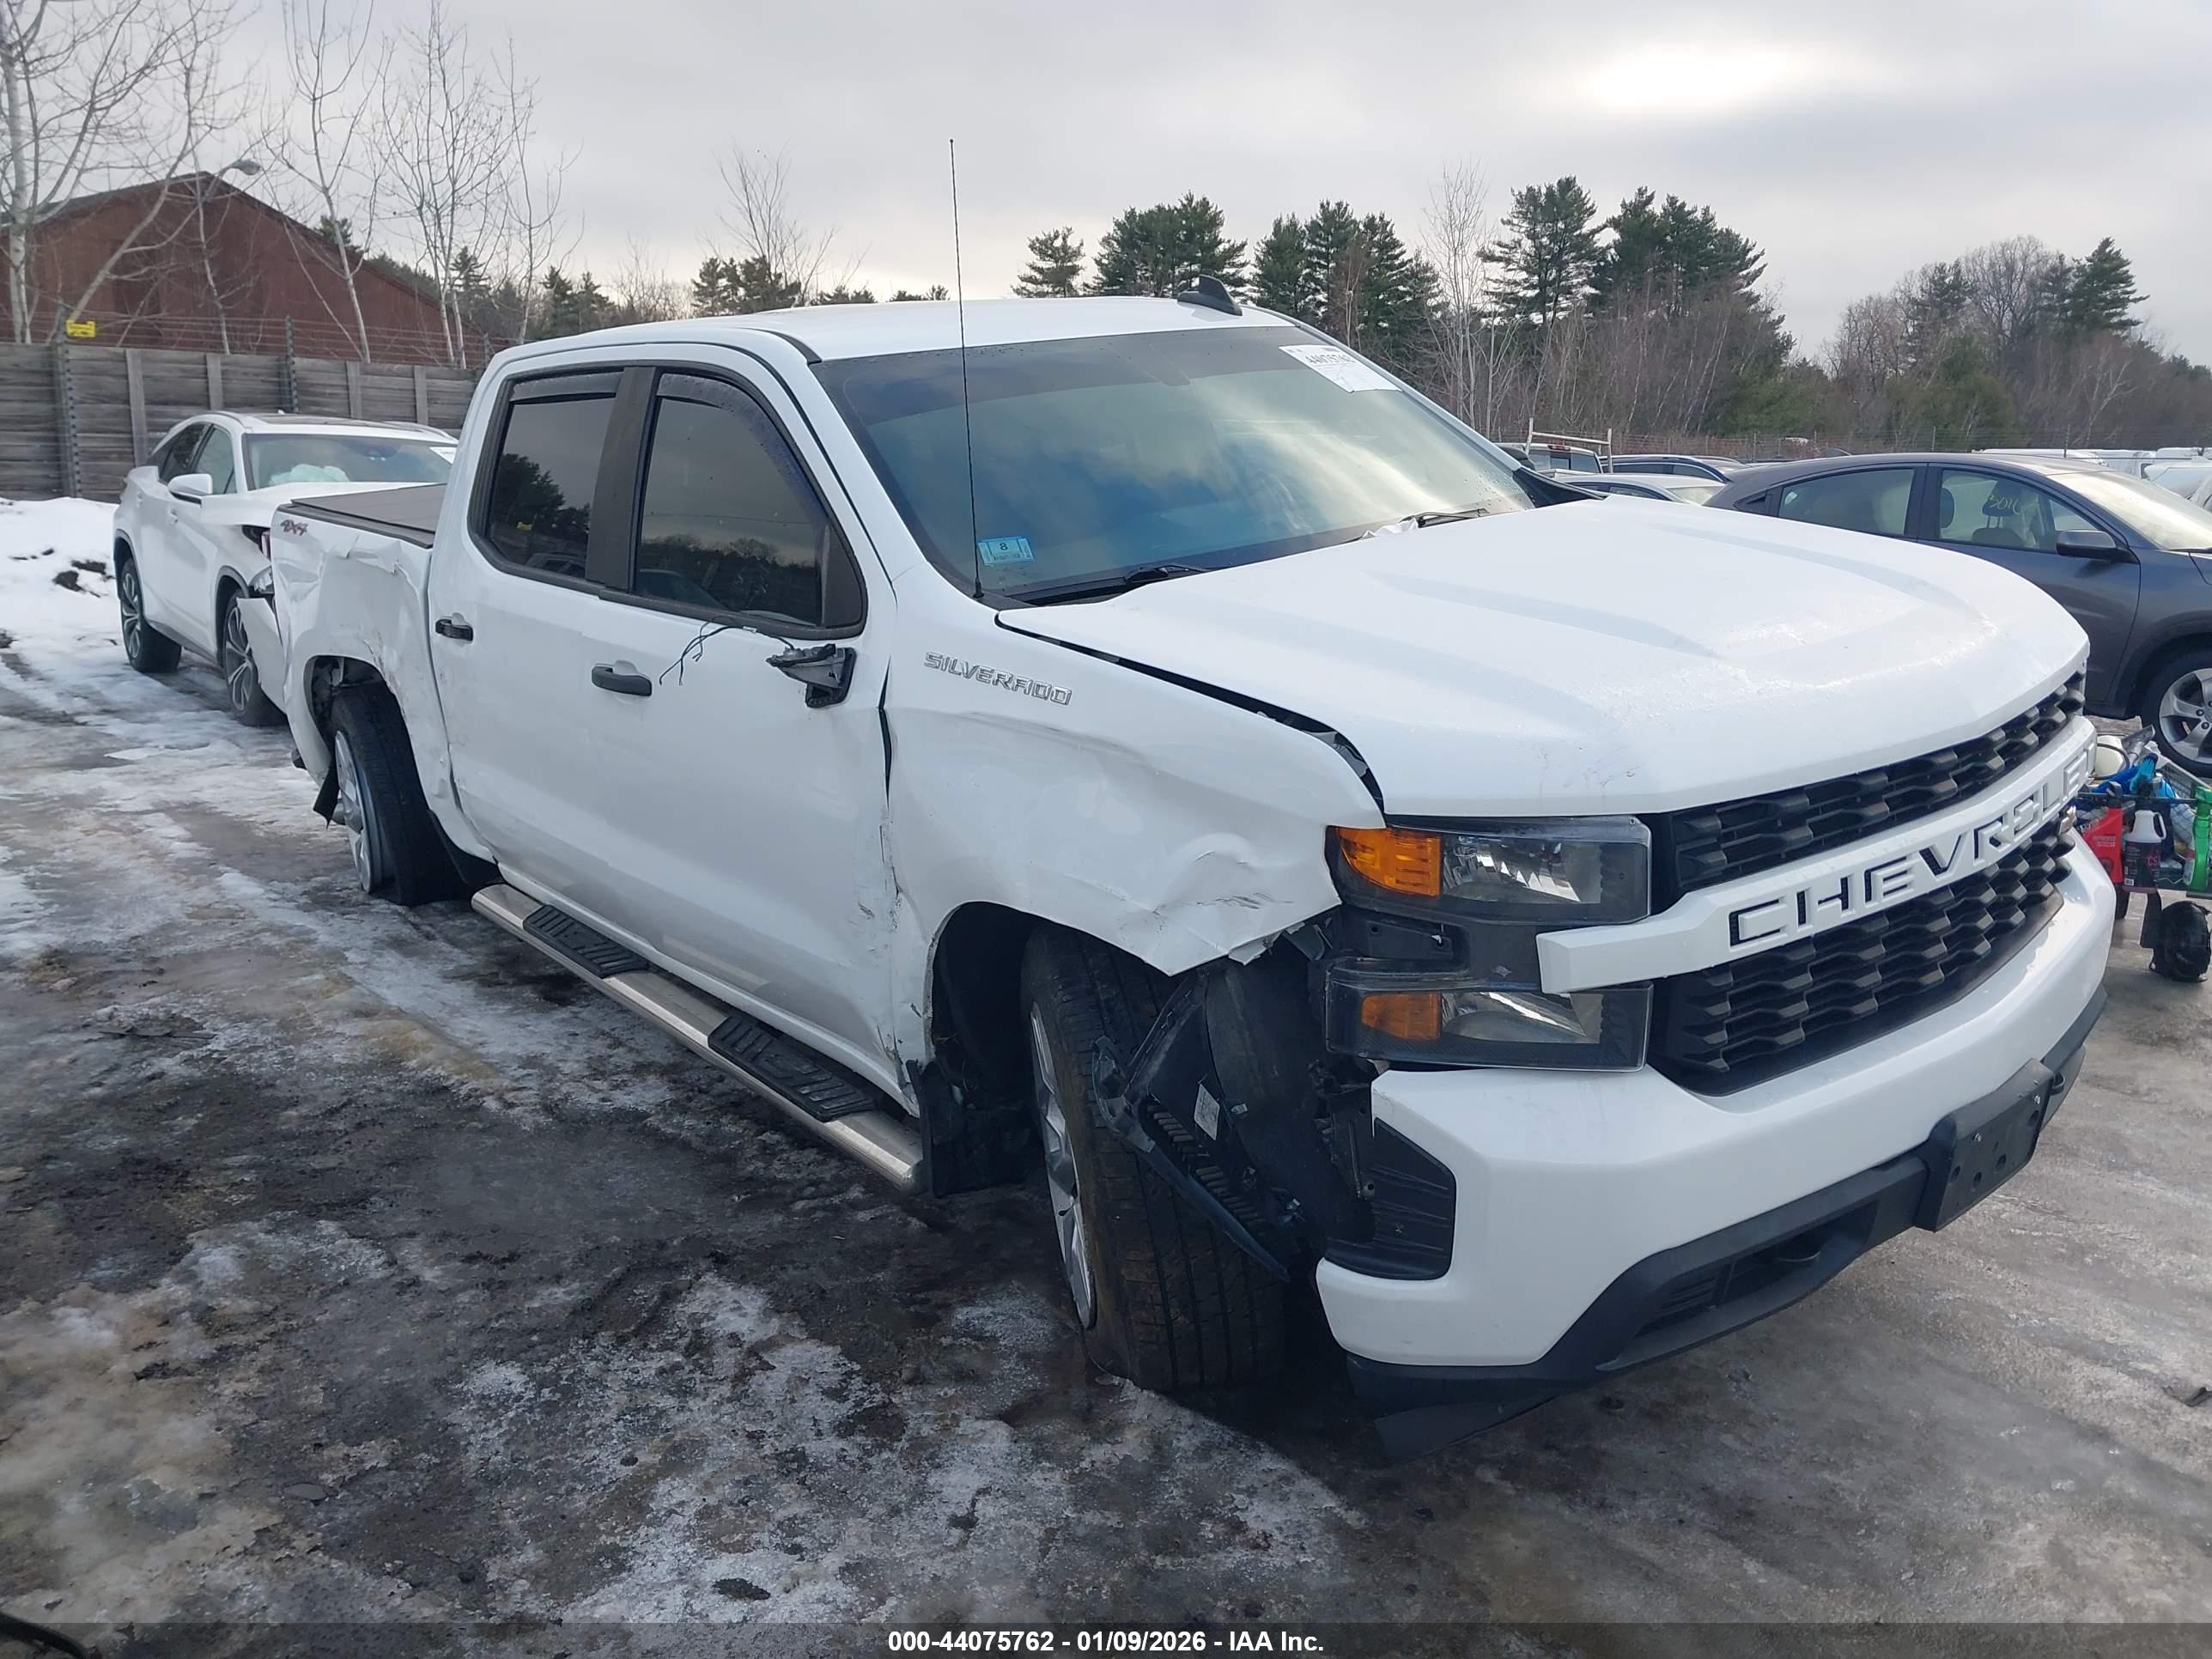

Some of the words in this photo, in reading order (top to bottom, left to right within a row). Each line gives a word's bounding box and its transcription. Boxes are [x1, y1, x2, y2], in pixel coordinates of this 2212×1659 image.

[999, 542, 1008, 550] 8
[924, 652, 1073, 706] SILVERADO
[1728, 739, 2097, 952] CHEVROLET
